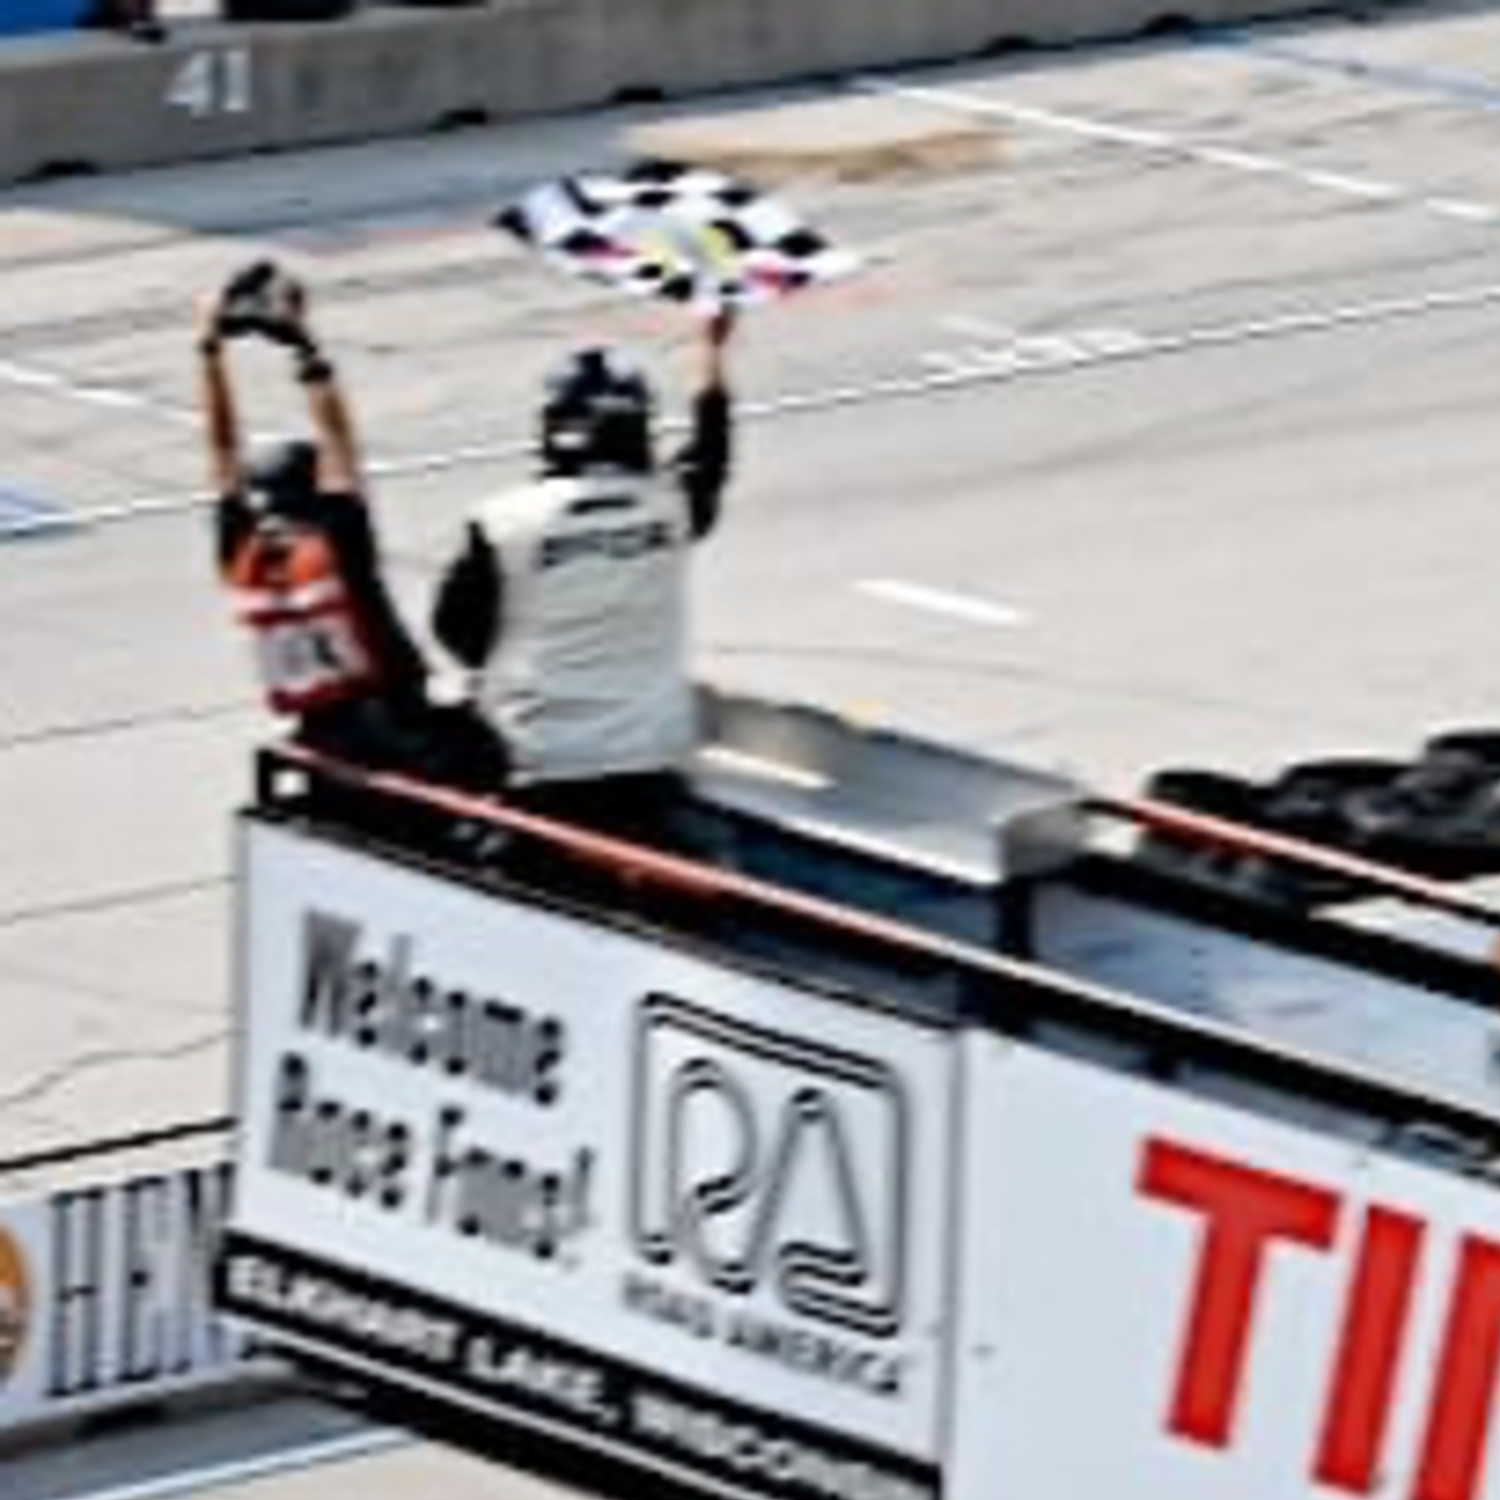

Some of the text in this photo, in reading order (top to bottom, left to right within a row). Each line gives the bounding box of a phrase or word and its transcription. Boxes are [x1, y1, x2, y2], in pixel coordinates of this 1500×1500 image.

[168, 48, 253, 116] 41
[298, 908, 568, 1108] Welcome
[266, 1050, 412, 1210] Race
[224, 1252, 462, 1366] ELKHART
